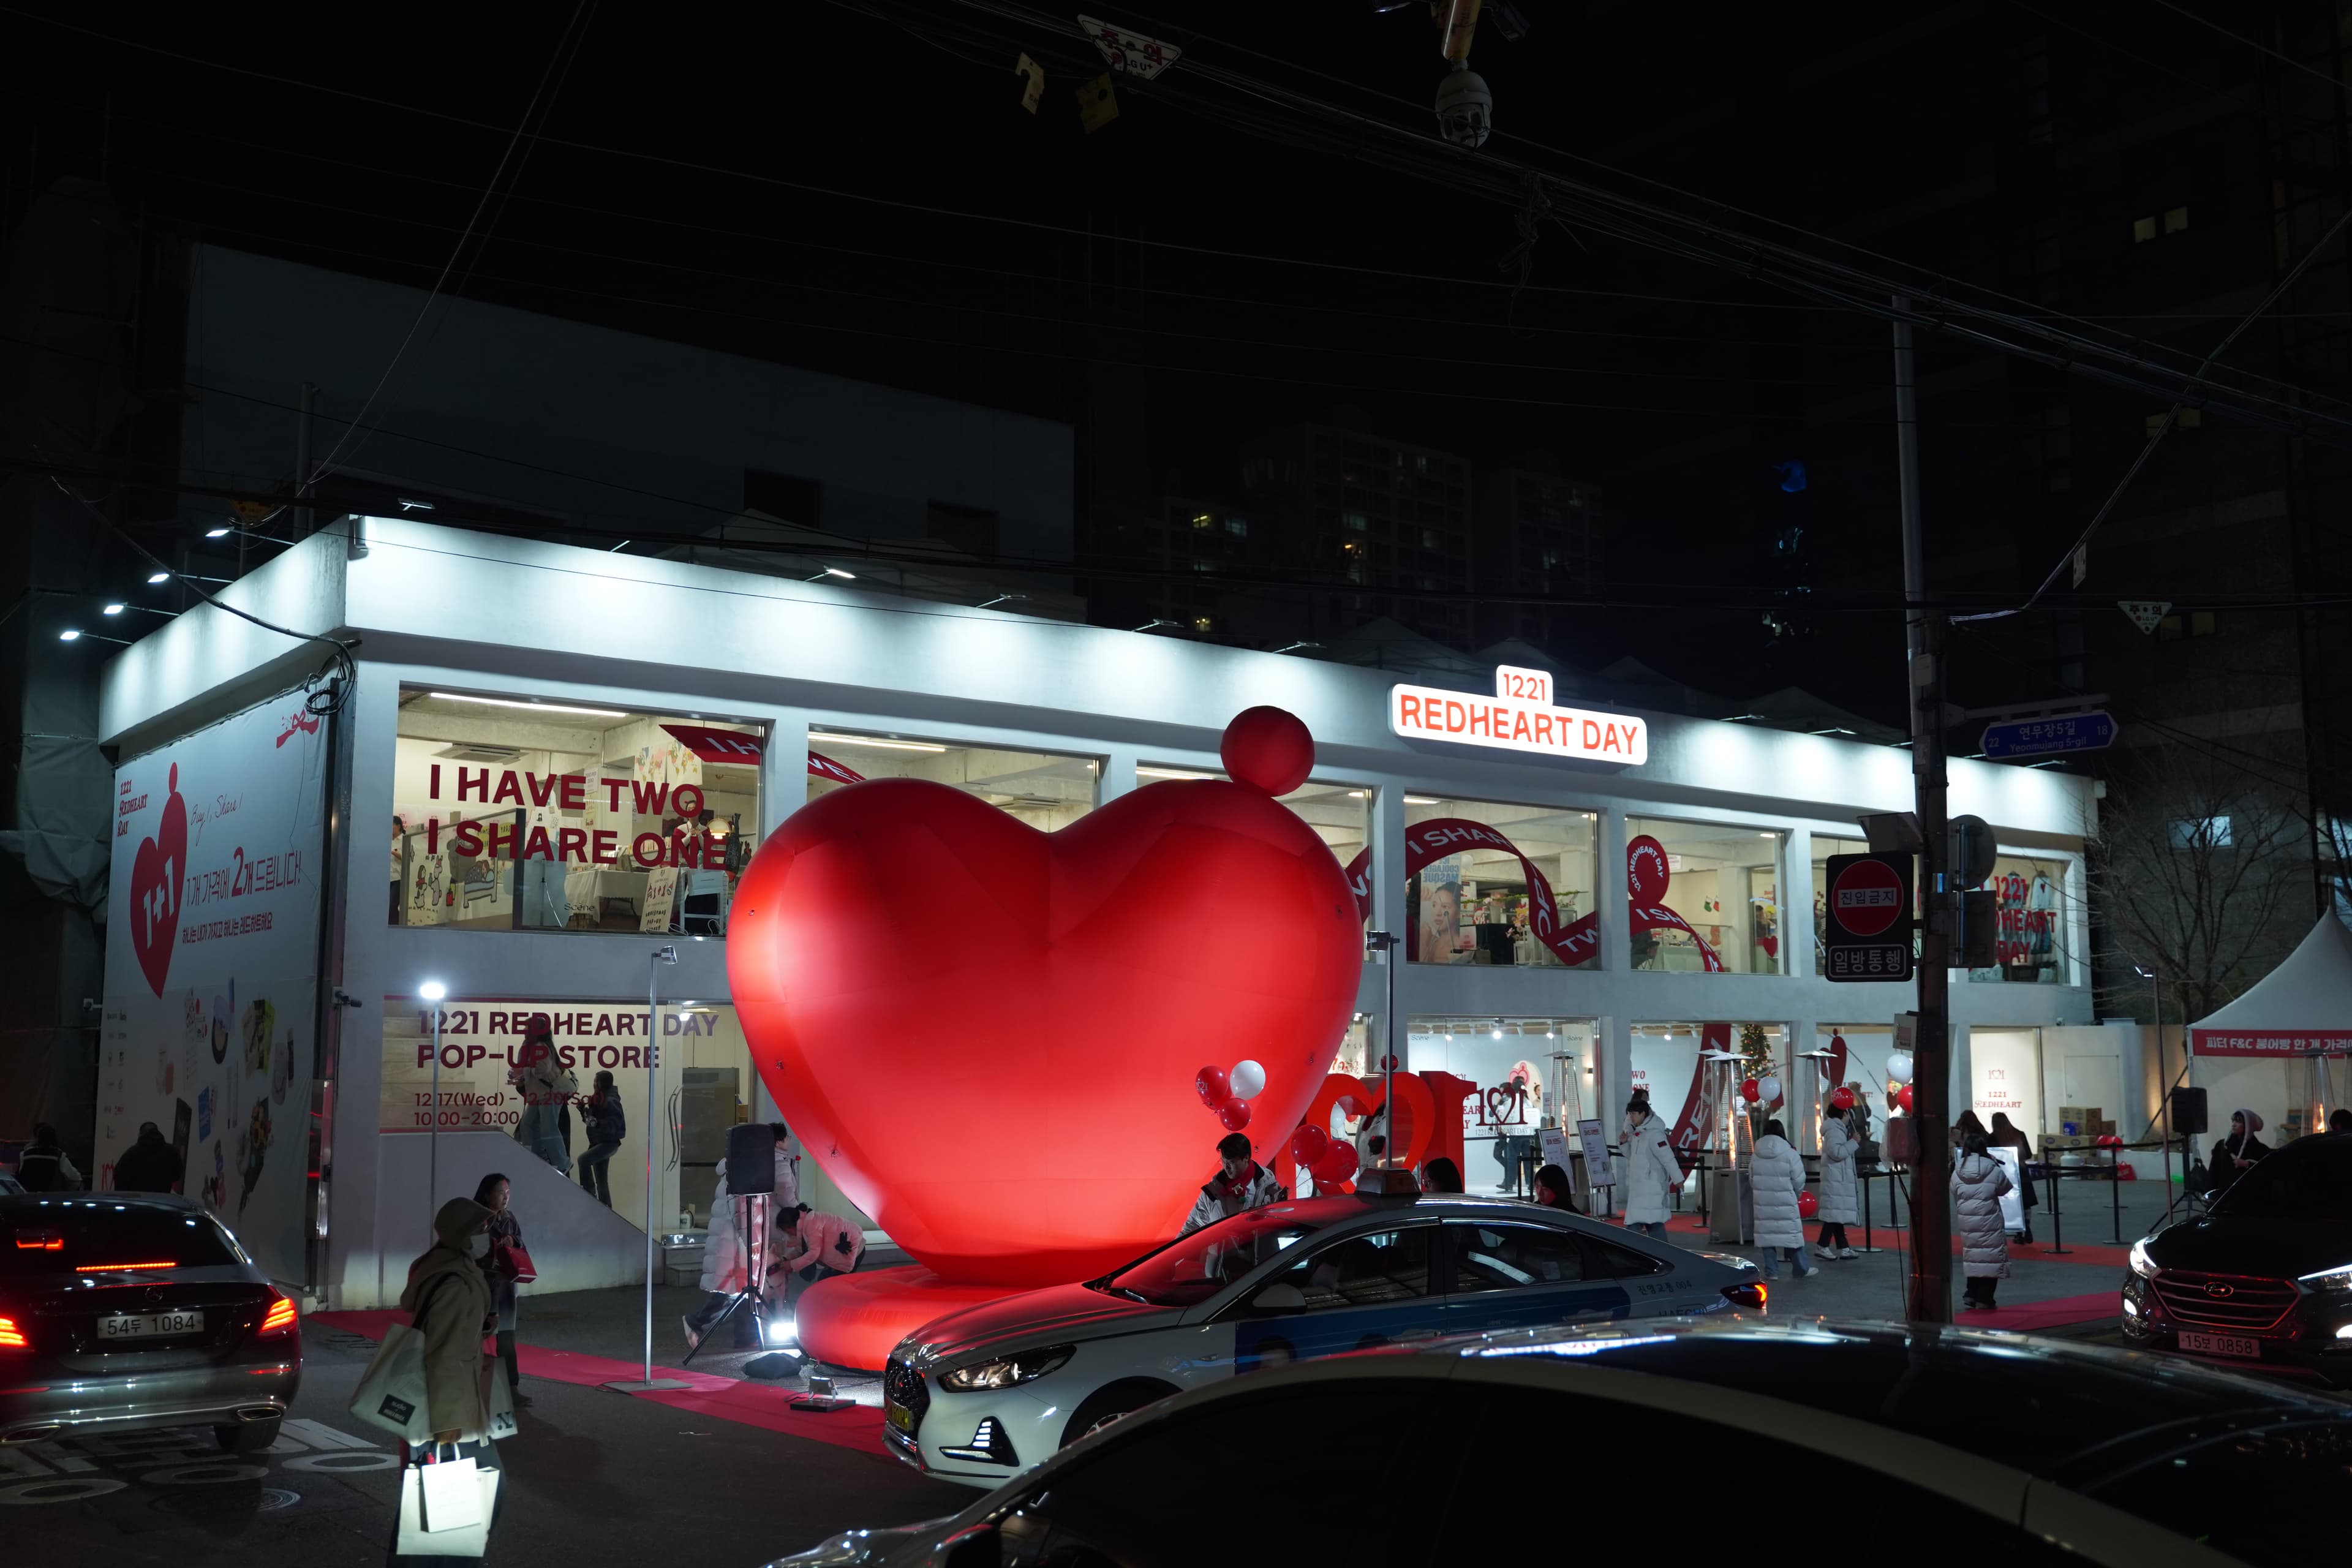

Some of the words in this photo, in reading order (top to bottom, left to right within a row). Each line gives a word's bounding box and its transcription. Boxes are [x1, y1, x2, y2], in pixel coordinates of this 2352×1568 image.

[1504, 673, 1545, 701] 1221
[1400, 694, 1573, 747] REDHEART
[1583, 719, 1637, 755] DAY
[2019, 720, 2076, 741] 연무장5길
[2097, 725, 2108, 735] 18
[1989, 737, 2000, 747] 22
[2010, 740, 2064, 753] Yeonmujang
[2066, 736, 2087, 747] 5-gil
[120, 780, 132, 796] 1221
[430, 764, 441, 799] I
[458, 767, 586, 810] HAVE
[601, 779, 704, 818] TWO
[119, 794, 148, 817] REDHEART
[118, 820, 129, 837] DAY
[428, 819, 439, 854] I
[455, 821, 619, 864] SHARE
[633, 832, 728, 869] ONE
[1630, 845, 1658, 872] REDHEART
[187, 874, 201, 907] 1개
[202, 867, 230, 903] 가격에
[232, 846, 254, 897] 2개
[255, 850, 302, 892] 드립니다!
[1841, 889, 1894, 905] 진입금지
[1994, 876, 2027, 903] 1221
[144, 856, 175, 949] 1+1
[183, 925, 197, 944] 하나는
[224, 918, 239, 937] 하나는
[1834, 949, 1901, 973] 일방통행
[1997, 940, 2030, 963] DAY
[418, 1011, 479, 1035] 1221
[490, 1012, 652, 1036] REDHEART
[663, 1014, 719, 1036] DAY
[2206, 1036, 2228, 1049] 피터
[2230, 1038, 2254, 1049] F&C
[2294, 1038, 2305, 1050] 한
[417, 1044, 548, 1069] POP-UP
[557, 1046, 660, 1069] STORE
[1631, 1071, 1646, 1079] WO
[415, 1092, 505, 1108] 1217(Wed)
[414, 1110, 519, 1126] 1000-20:00
[107, 1319, 141, 1335] 54두
[151, 1314, 195, 1332] 1084
[2217, 1338, 2253, 1354] 0858
